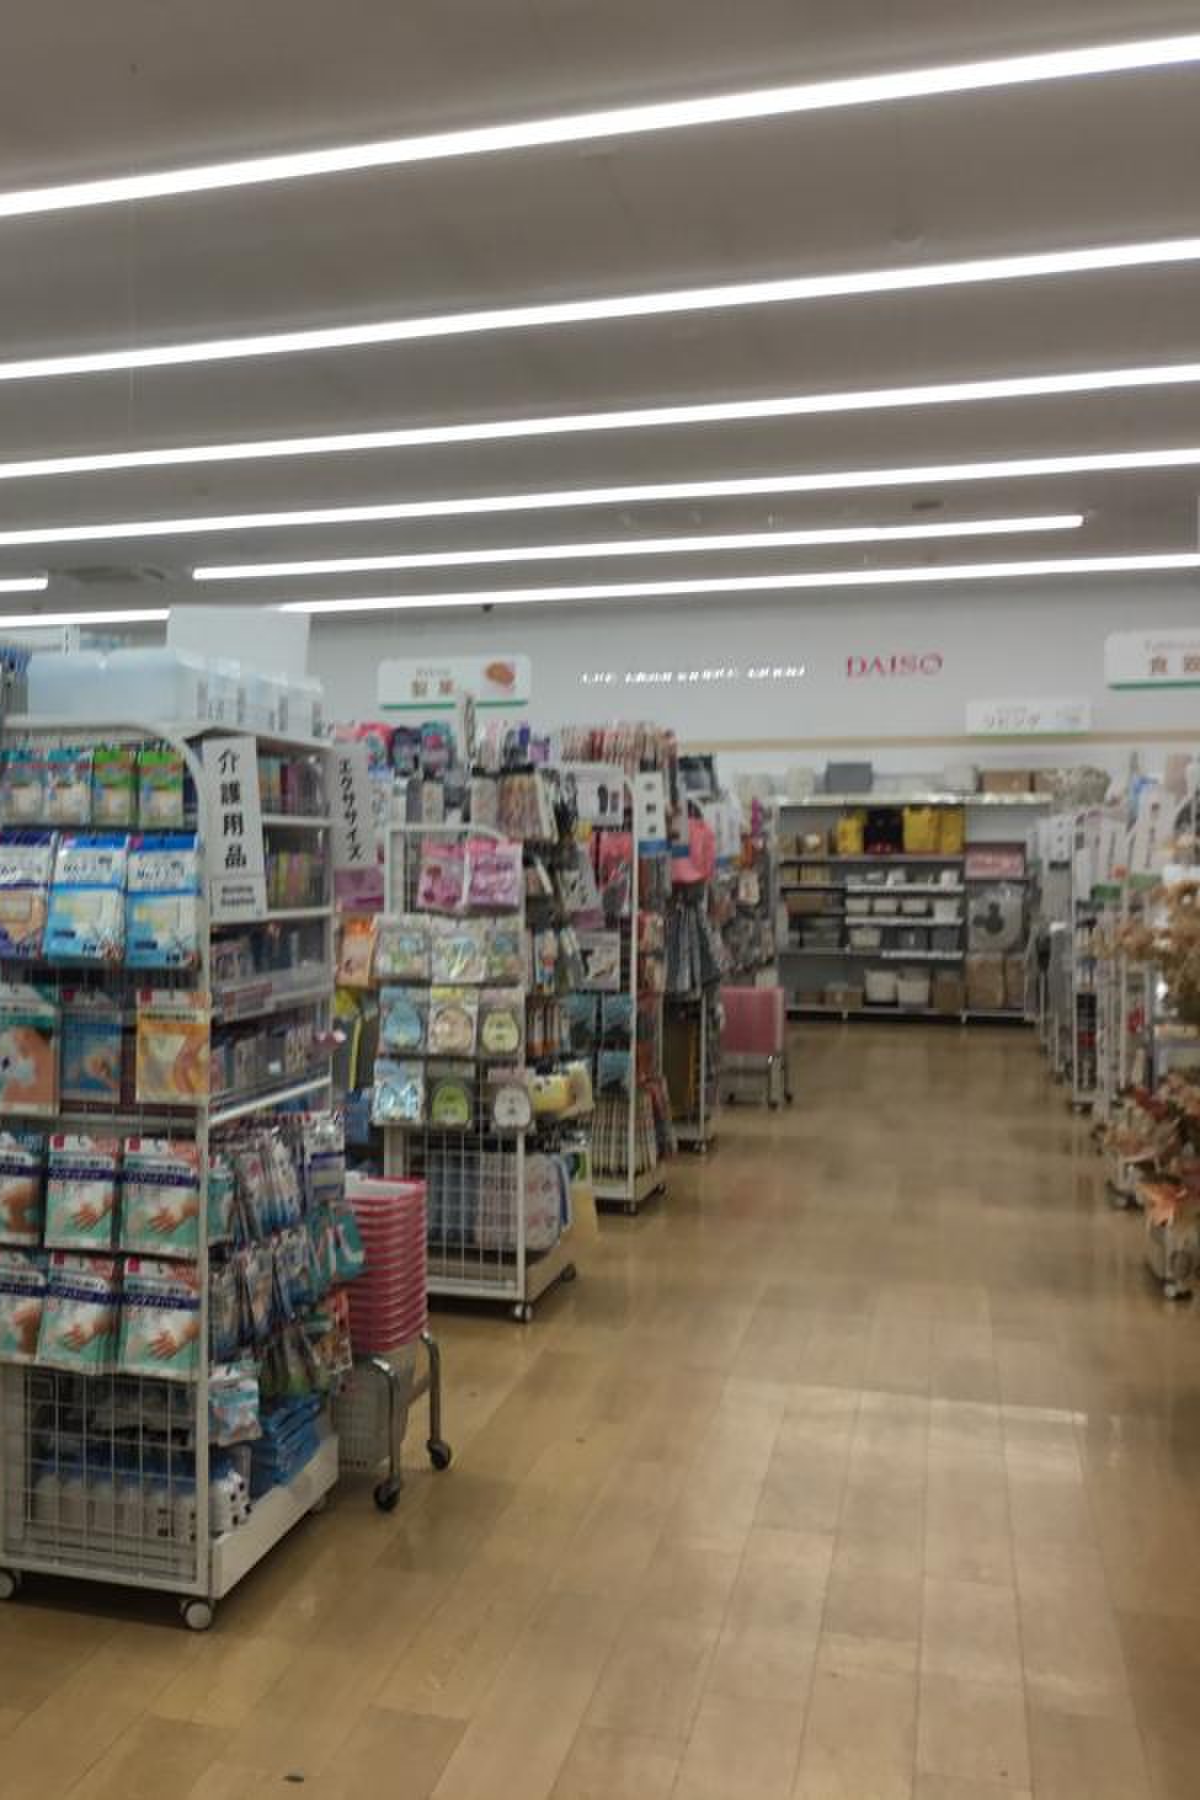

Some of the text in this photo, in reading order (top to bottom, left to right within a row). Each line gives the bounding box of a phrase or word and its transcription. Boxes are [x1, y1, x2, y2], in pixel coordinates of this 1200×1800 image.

[846, 652, 944, 678] DAISO
[218, 748, 247, 870] 介護用品
